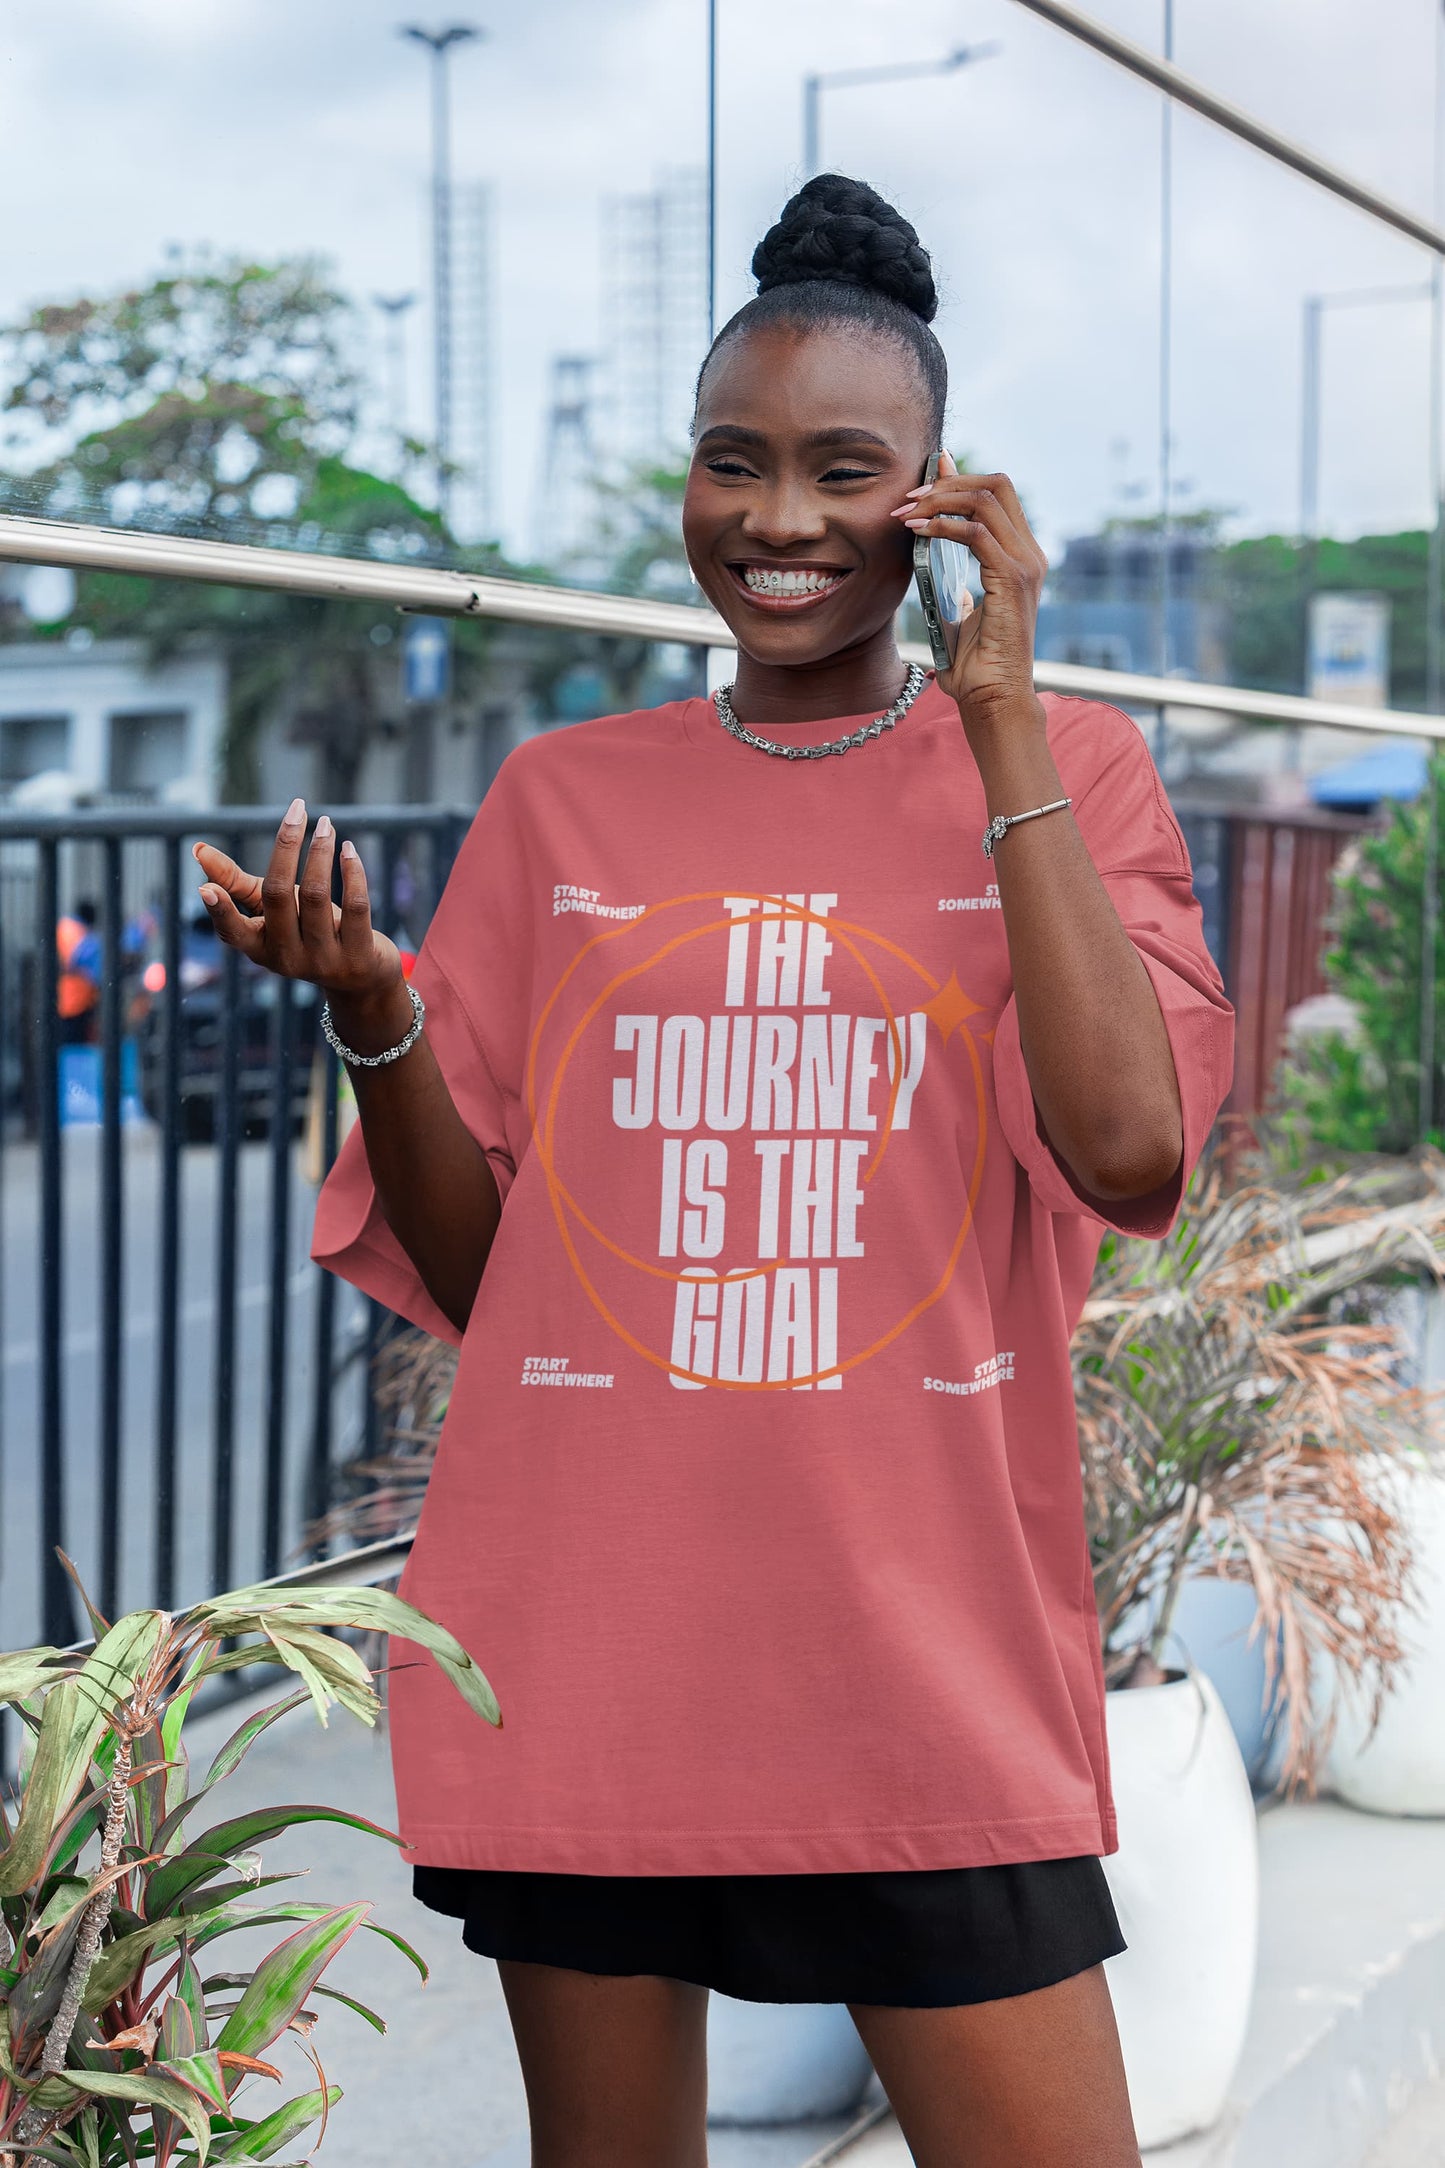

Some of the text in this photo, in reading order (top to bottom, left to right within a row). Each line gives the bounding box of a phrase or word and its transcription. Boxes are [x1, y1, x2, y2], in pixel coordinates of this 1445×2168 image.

[553, 885, 600, 903] START
[937, 897, 1002, 912] SOMEWH
[553, 898, 646, 920] SOMEWHERE
[723, 893, 838, 1007] THE
[612, 1012, 927, 1132] JOURNEY
[659, 1139, 868, 1259] IS THE
[669, 1266, 843, 1391] GOAL
[523, 1357, 570, 1372] START
[974, 1352, 1015, 1380] START
[520, 1372, 615, 1388] SOMEWHERE
[923, 1366, 1015, 1396] SOMEWHERE
